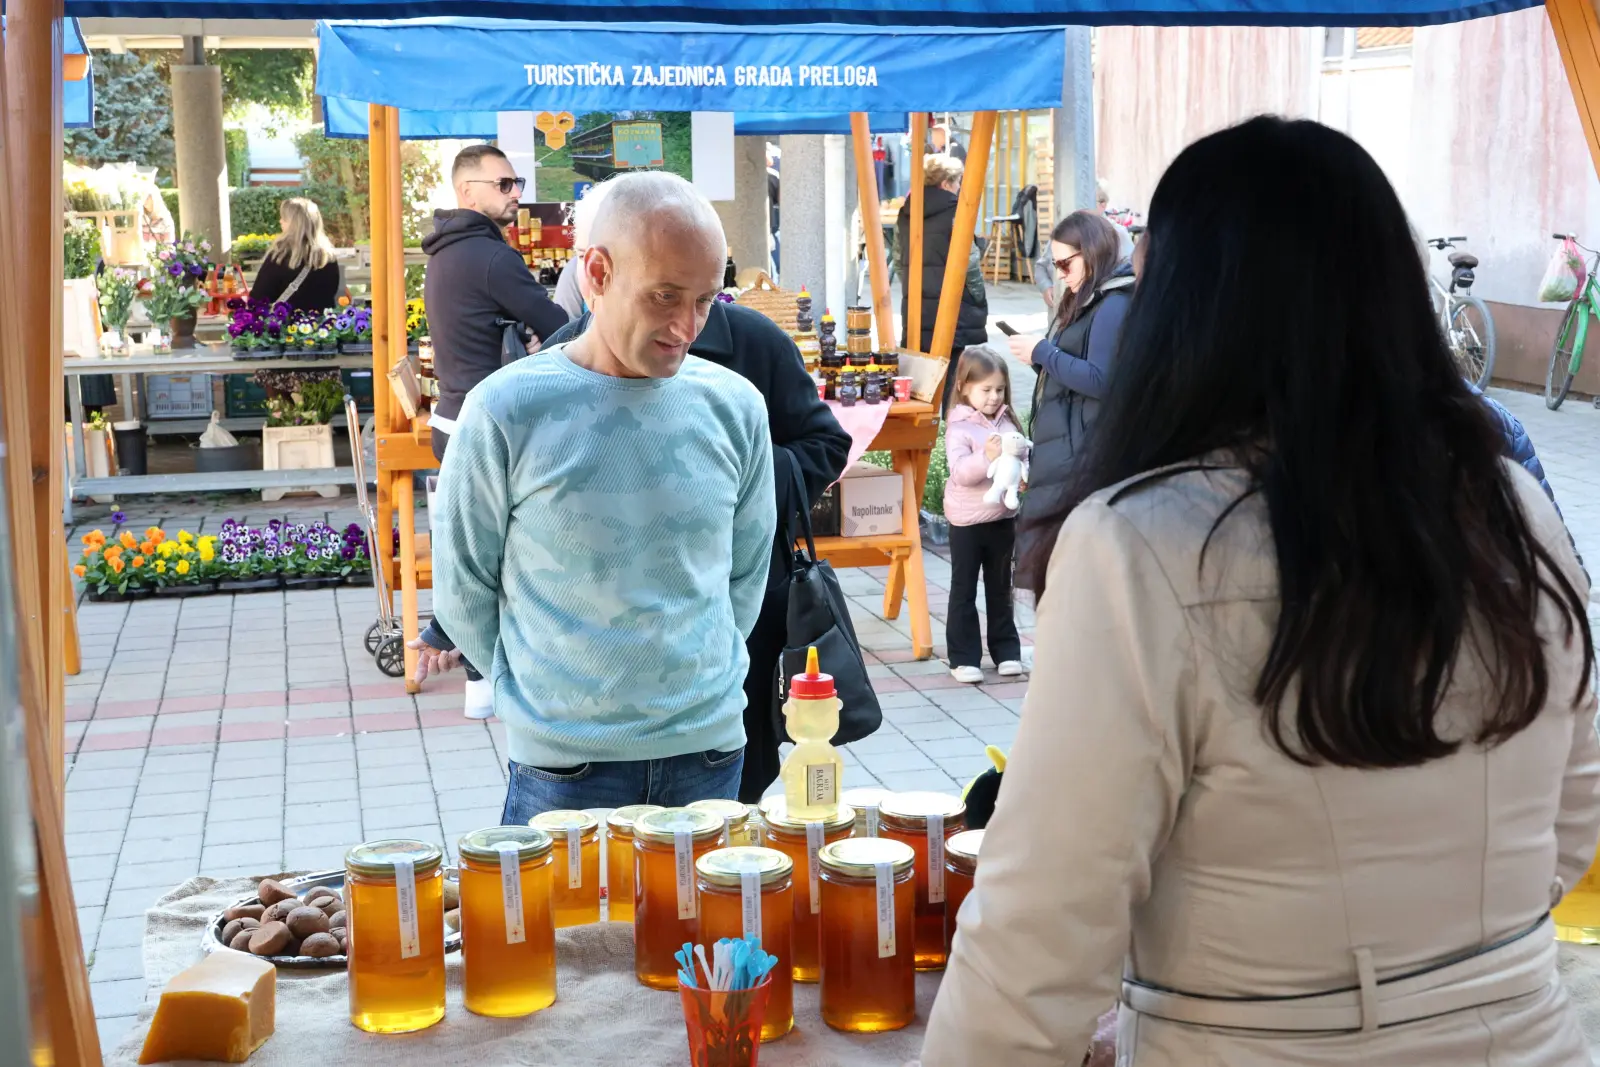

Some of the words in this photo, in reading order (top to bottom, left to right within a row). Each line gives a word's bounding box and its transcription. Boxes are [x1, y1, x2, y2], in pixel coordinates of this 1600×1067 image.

[524, 62, 625, 86] TURISTIČKA
[631, 65, 726, 87] ZAJEDNICA
[734, 66, 793, 87] GRADA
[799, 66, 878, 87] PRELOGA
[852, 504, 893, 518] Napolitanke
